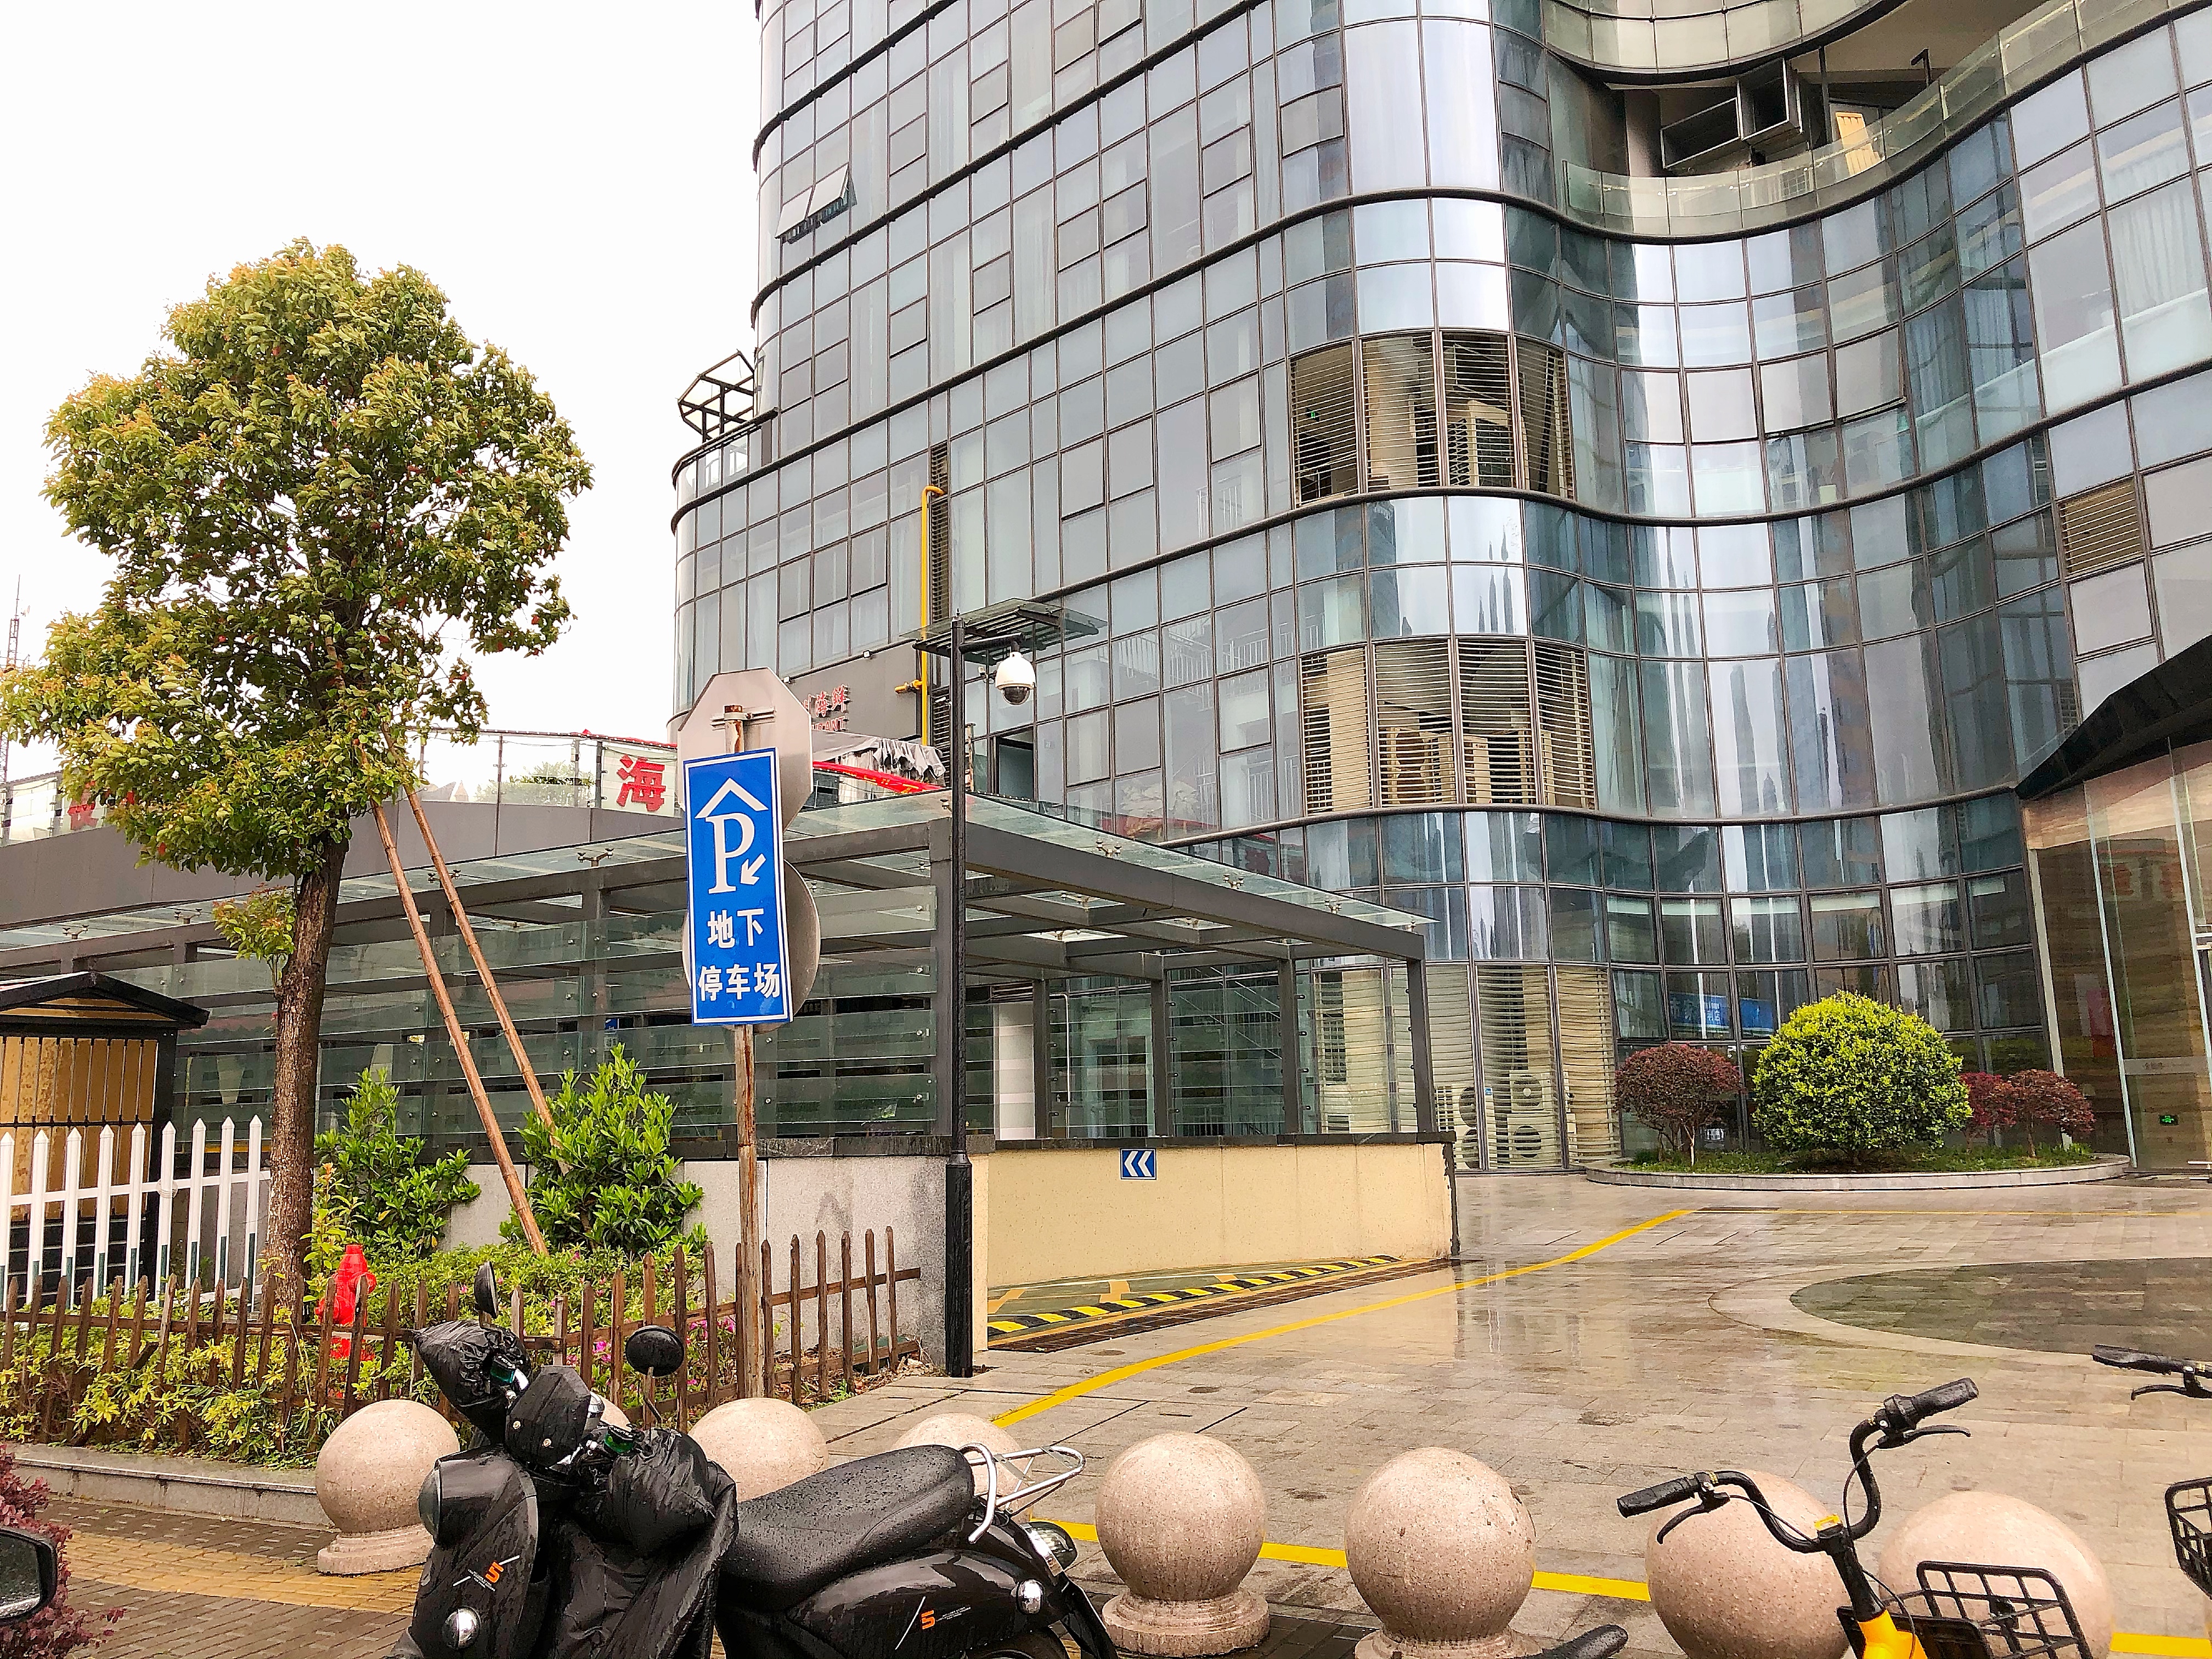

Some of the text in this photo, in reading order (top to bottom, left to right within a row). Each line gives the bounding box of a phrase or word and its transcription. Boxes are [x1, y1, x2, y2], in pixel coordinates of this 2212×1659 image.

[617, 754, 666, 811] 海
[706, 812, 755, 894] P
[707, 908, 764, 949] 地下
[698, 962, 781, 1002] 停车场
